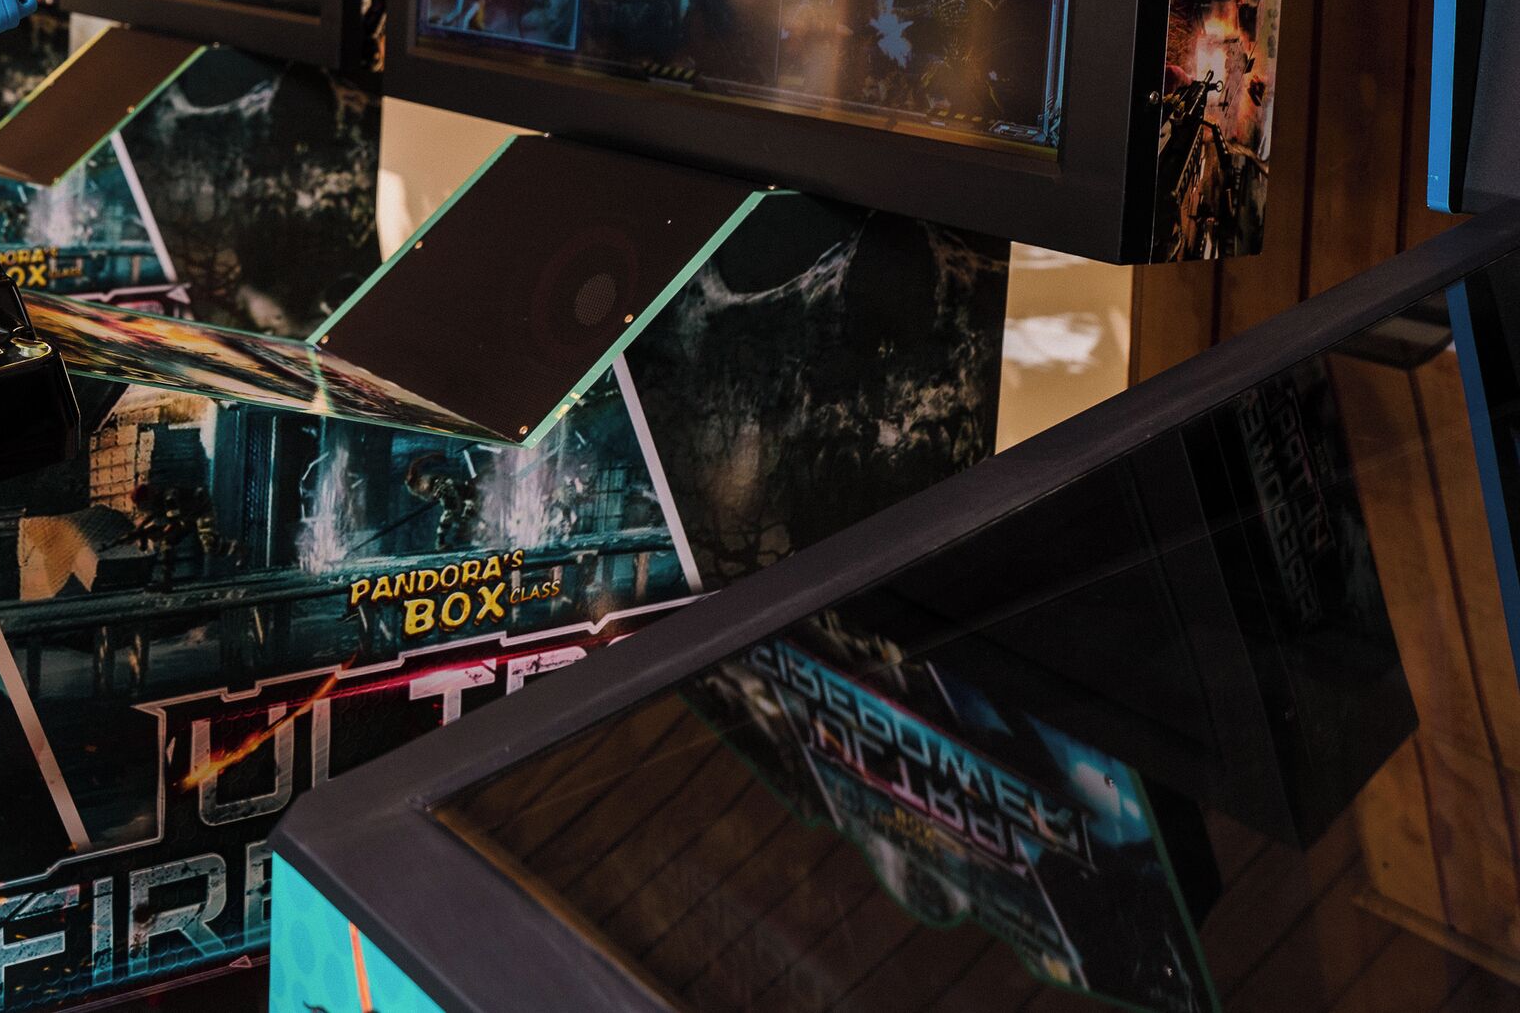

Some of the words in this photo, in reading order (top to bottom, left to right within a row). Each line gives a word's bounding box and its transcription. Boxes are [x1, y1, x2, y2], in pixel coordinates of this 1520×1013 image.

[5, 264, 48, 287] OX
[350, 549, 524, 606] PANDORA'S
[403, 582, 506, 636] BOX
[509, 580, 561, 604] CLASS
